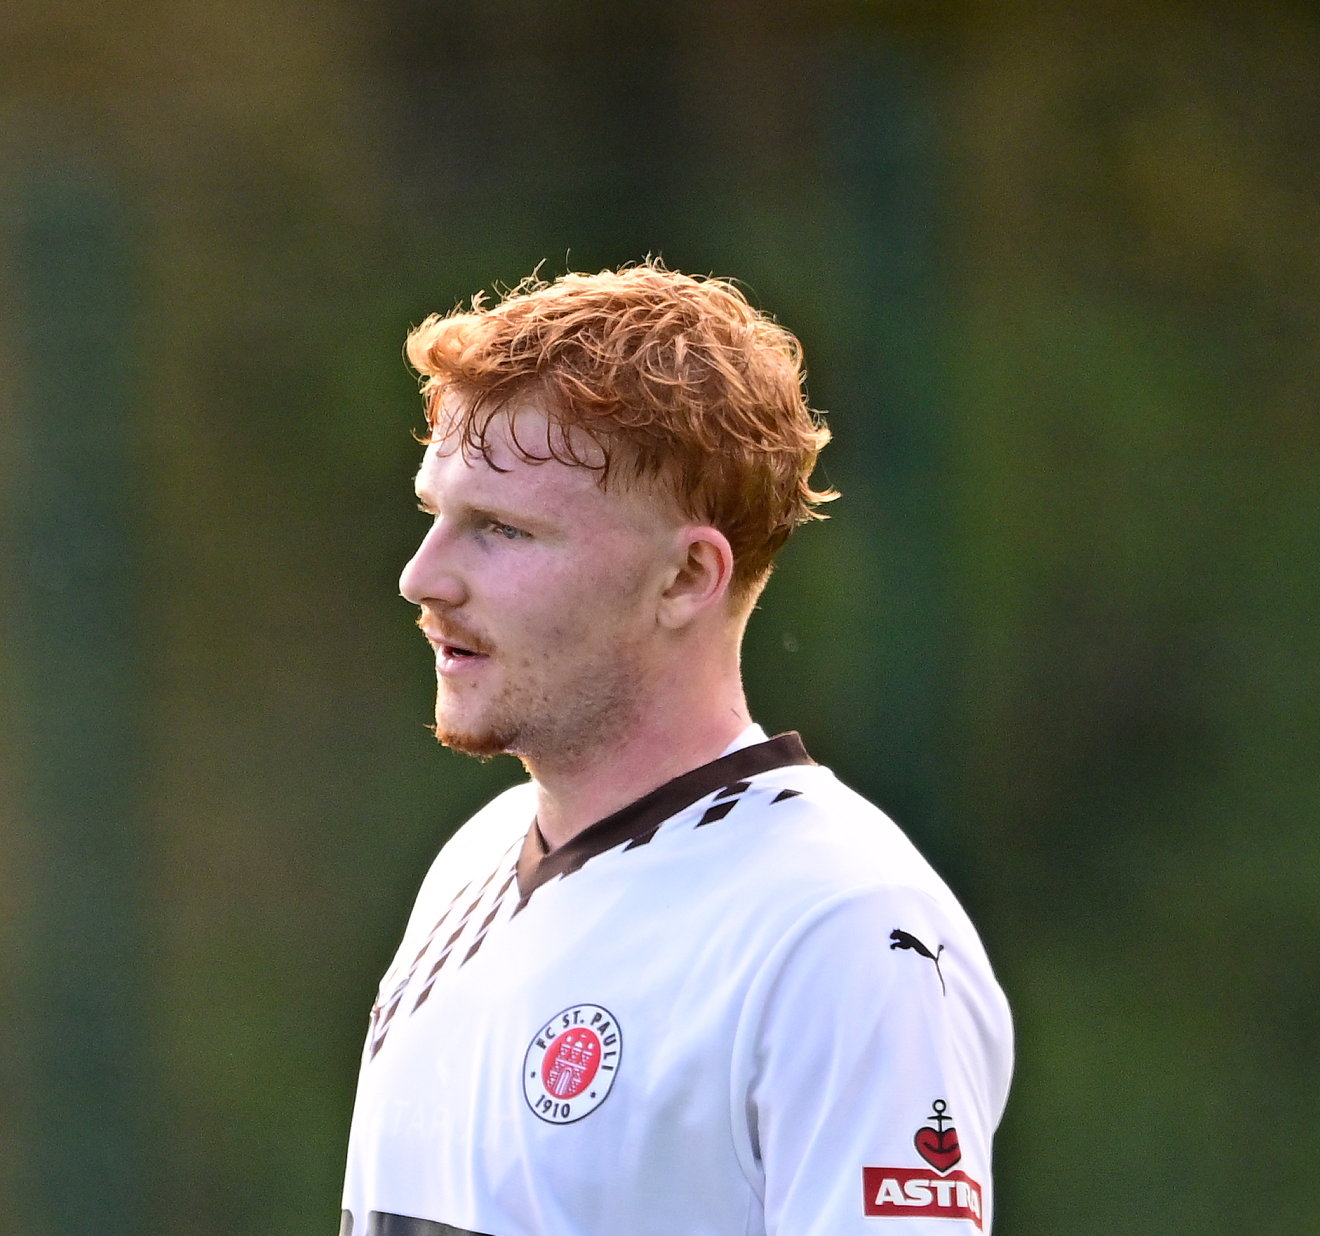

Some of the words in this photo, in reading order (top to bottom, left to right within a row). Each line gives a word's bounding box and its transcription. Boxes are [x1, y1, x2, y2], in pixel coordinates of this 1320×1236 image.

[535, 1026, 556, 1050] FC
[562, 1010, 585, 1028] ST.
[589, 1012, 617, 1071] PAULI
[535, 1094, 571, 1118] 1910
[874, 1177, 981, 1219] ASTRA
